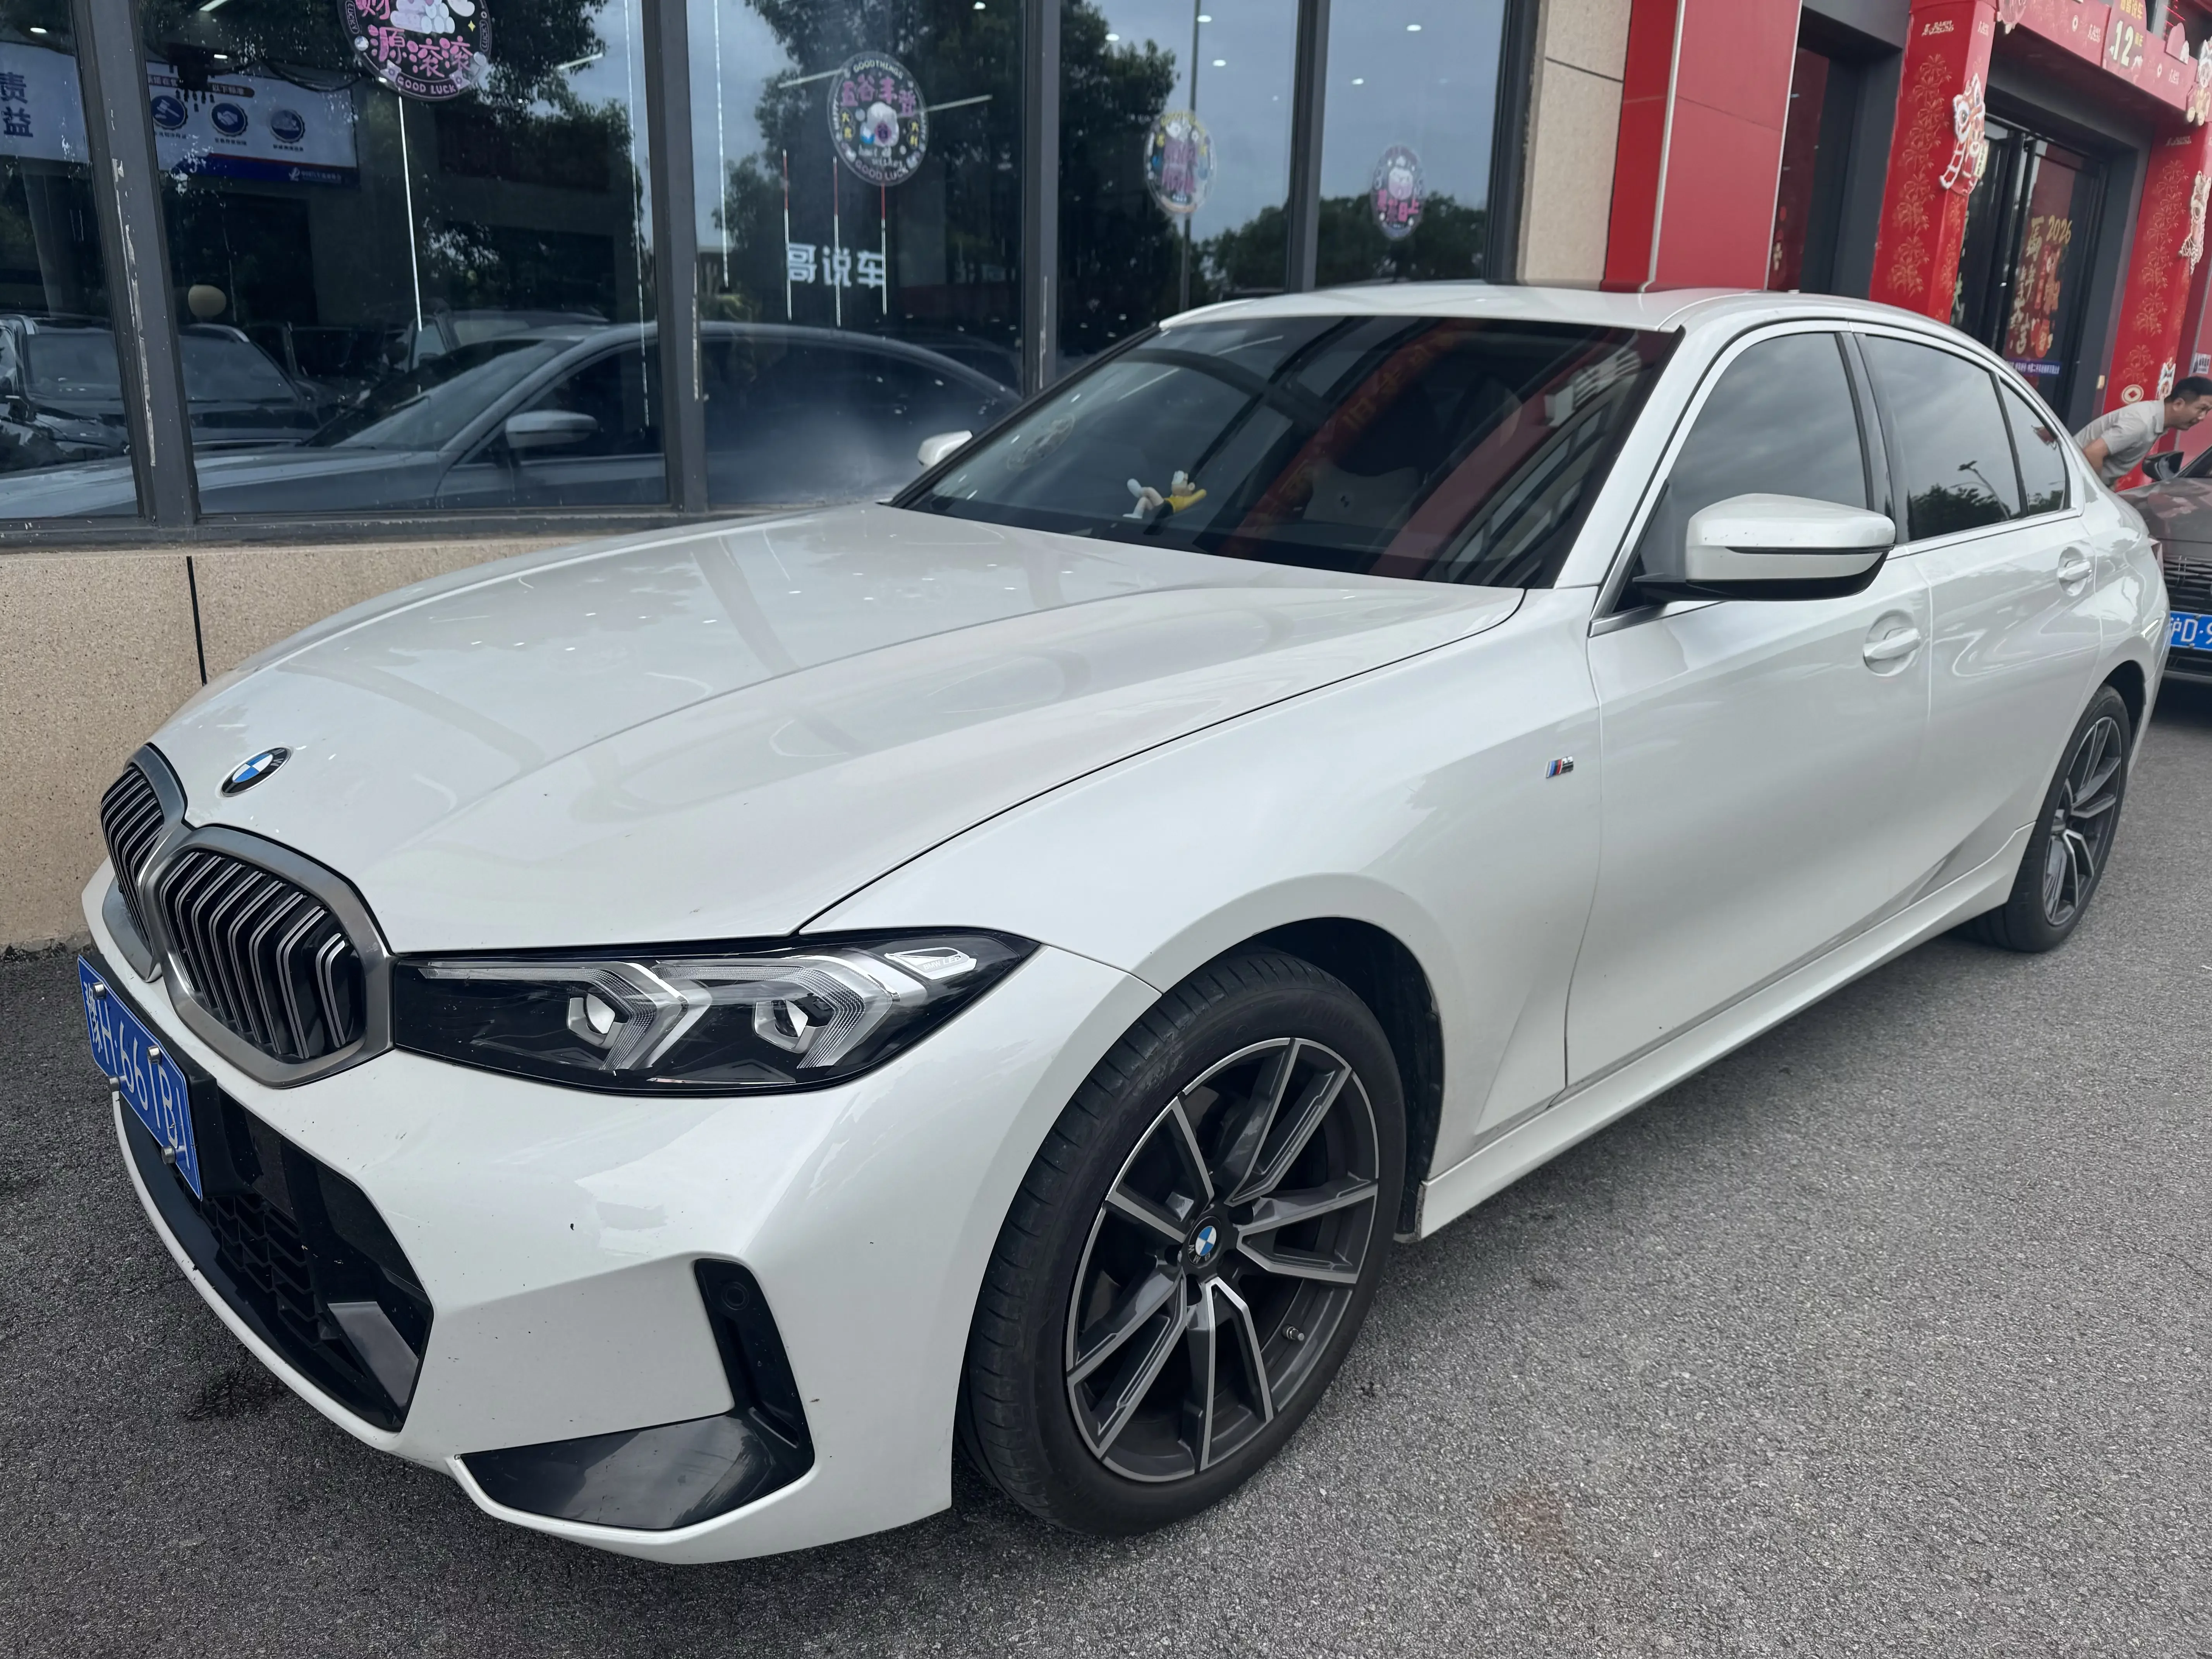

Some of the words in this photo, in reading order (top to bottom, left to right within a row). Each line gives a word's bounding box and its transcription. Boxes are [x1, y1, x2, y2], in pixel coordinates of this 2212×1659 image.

[397, 76, 426, 93] GOOD
[430, 84, 457, 94] LUCK
[2046, 215, 2072, 244] 2026
[786, 242, 887, 289] 哥说车
